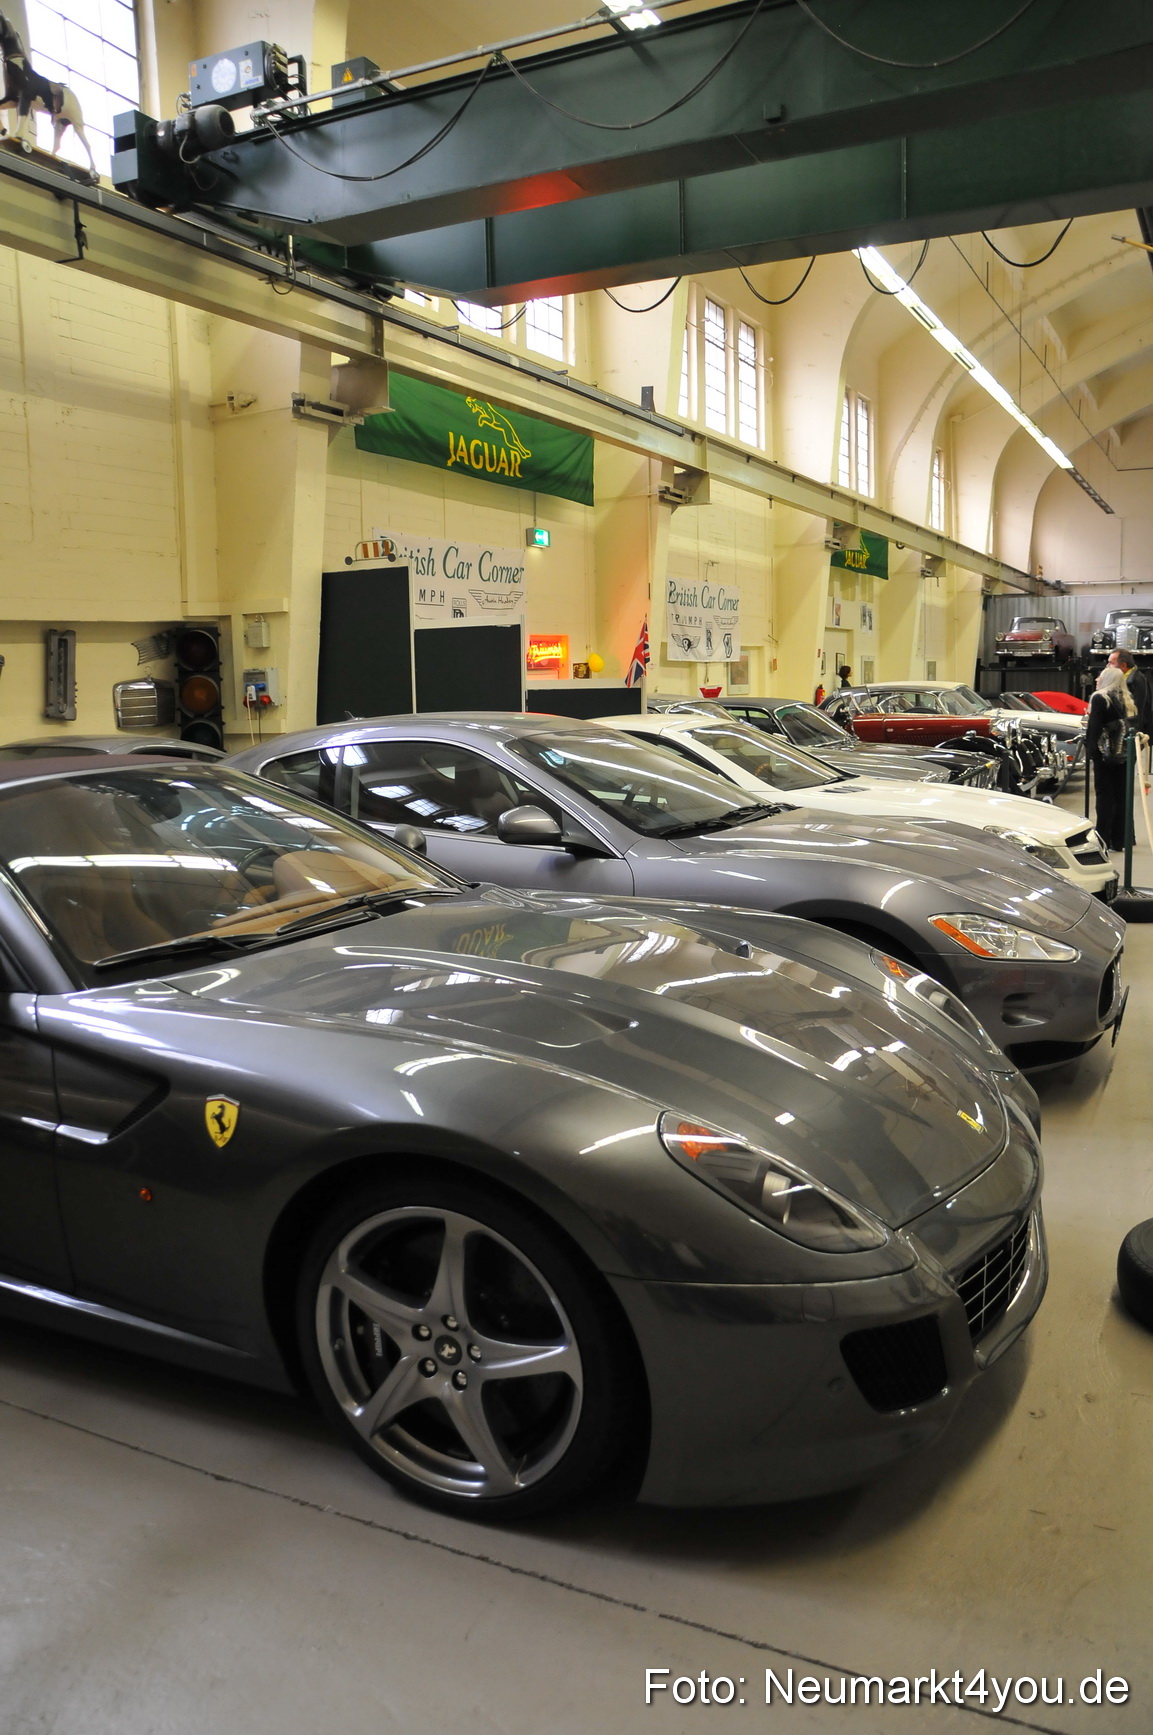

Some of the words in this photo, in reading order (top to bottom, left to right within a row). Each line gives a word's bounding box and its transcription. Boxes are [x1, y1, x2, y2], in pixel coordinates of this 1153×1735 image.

[447, 431, 523, 478] JAGUAR
[442, 545, 473, 580] Car
[478, 550, 525, 584] Corner
[668, 580, 698, 608] British
[701, 585, 716, 609] Car
[717, 587, 740, 611] Corner
[671, 613, 703, 626] TRIUMPH
